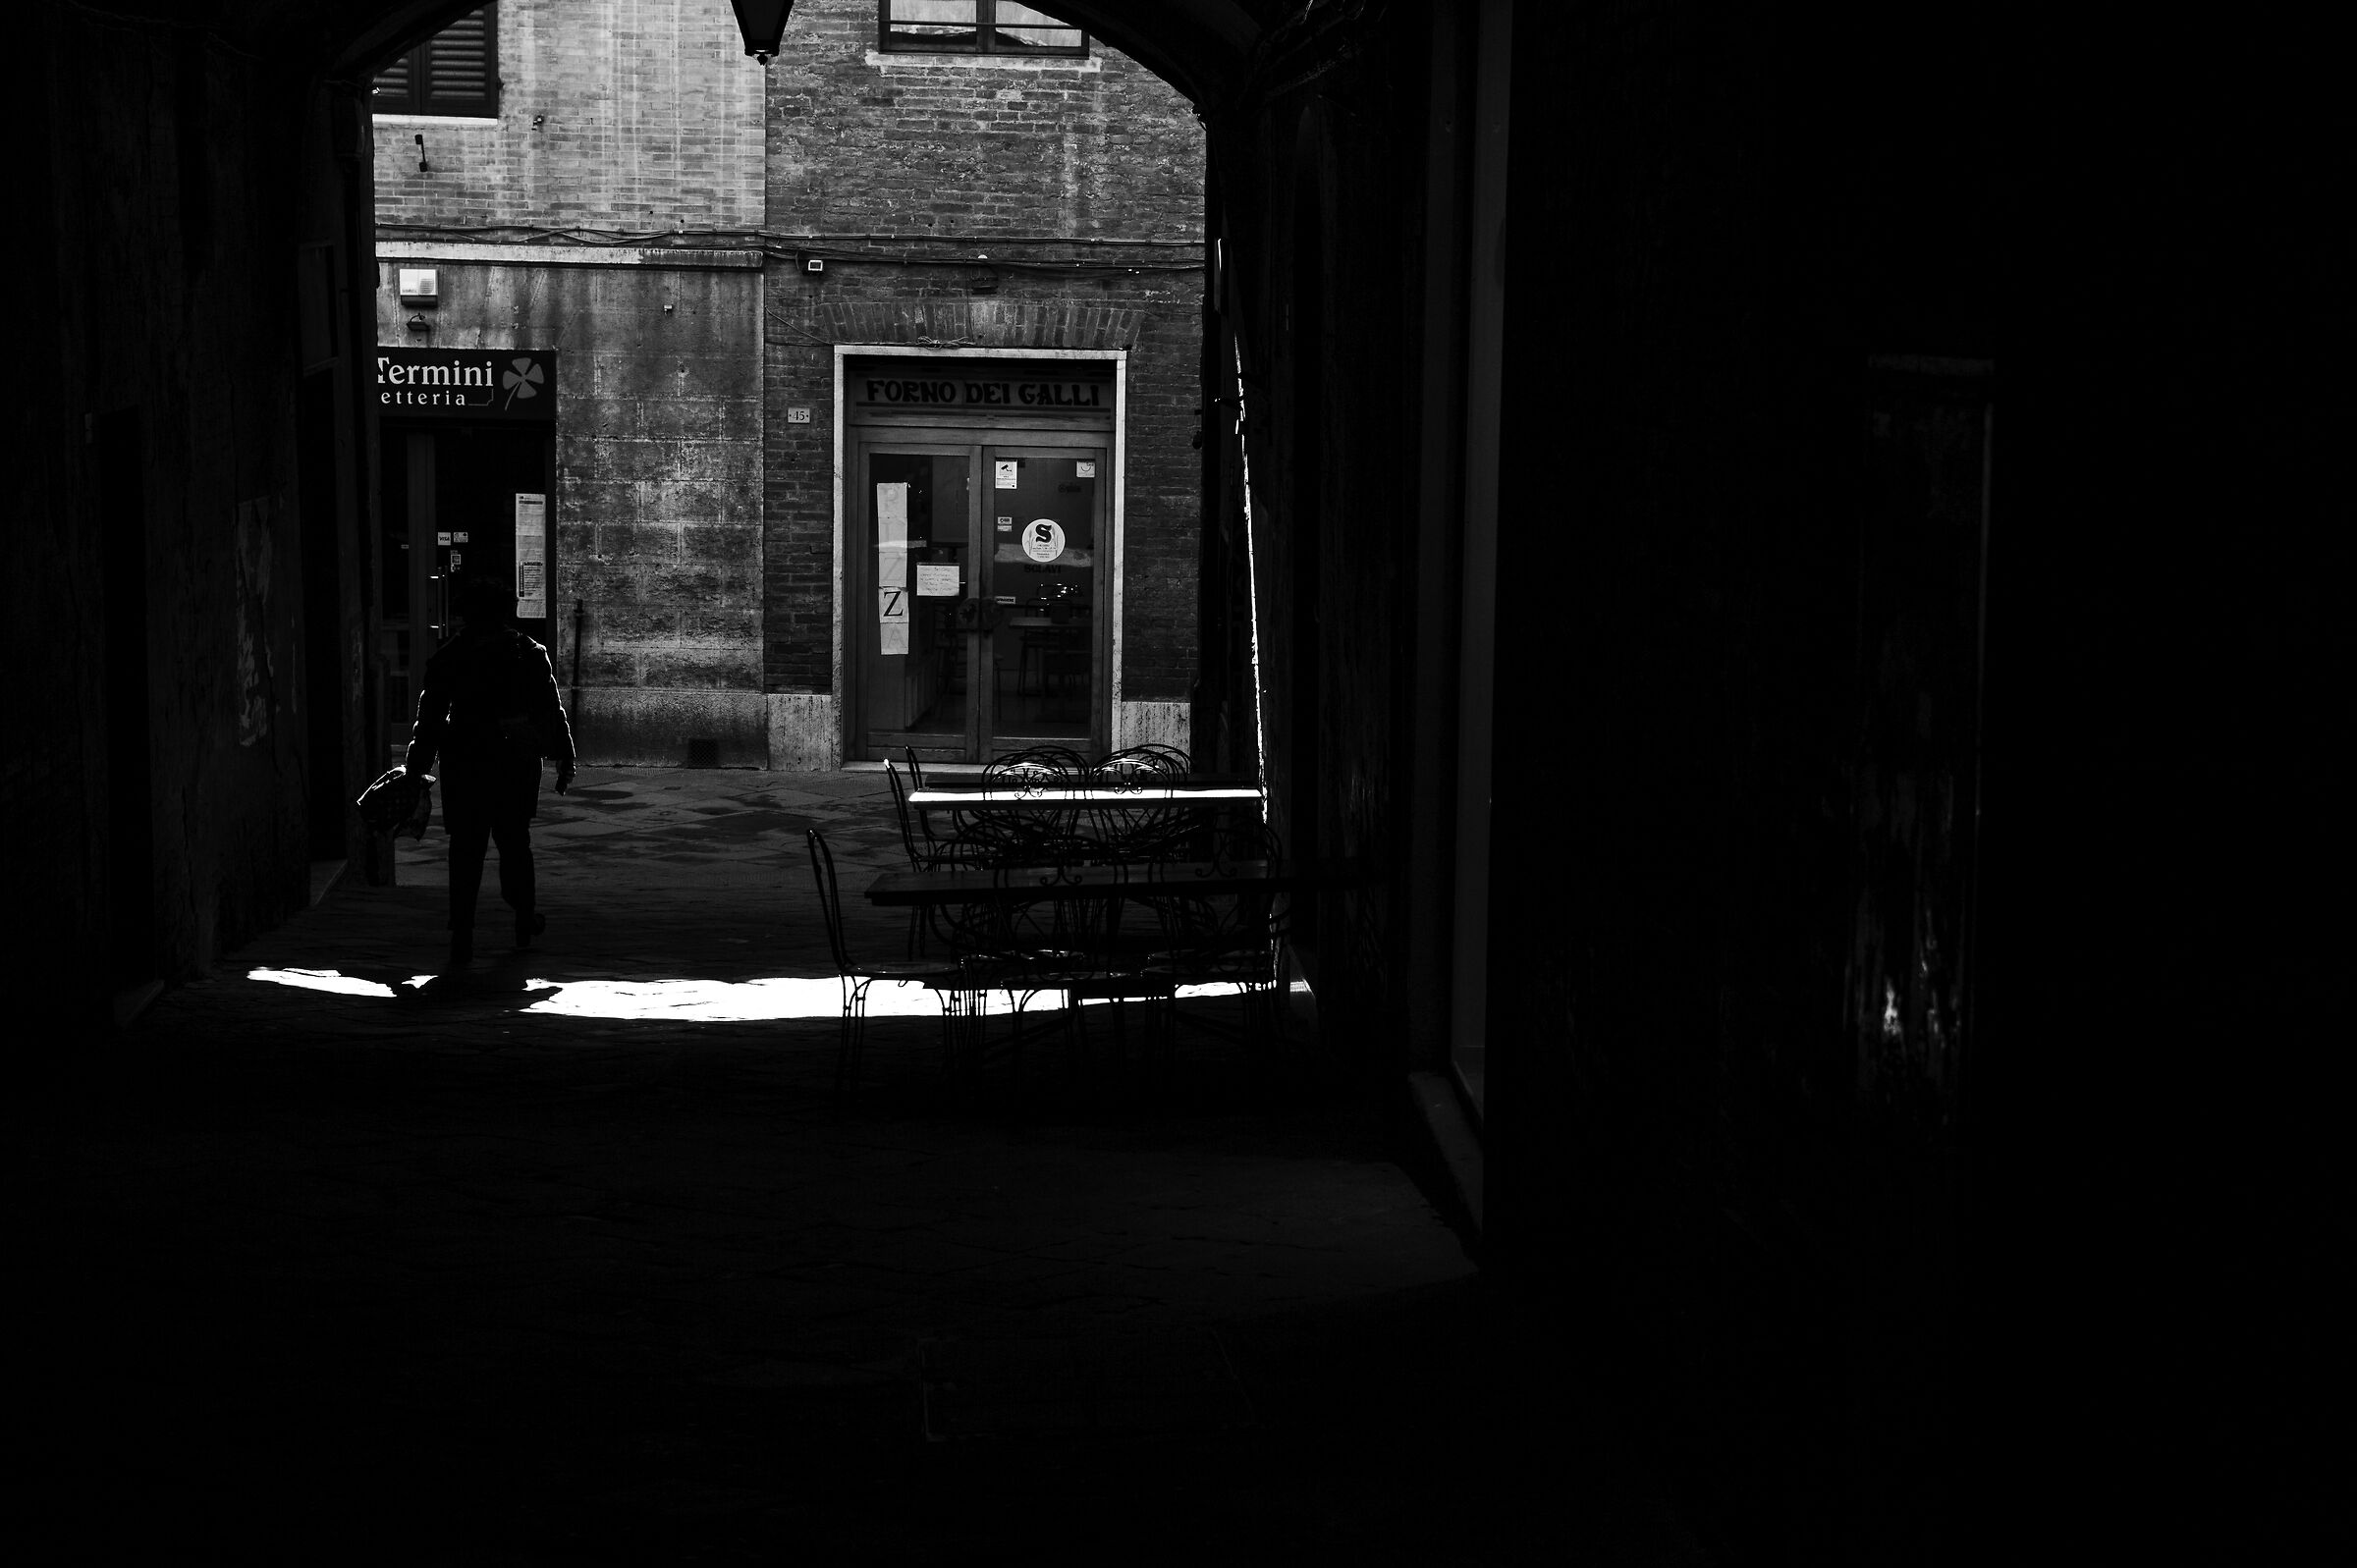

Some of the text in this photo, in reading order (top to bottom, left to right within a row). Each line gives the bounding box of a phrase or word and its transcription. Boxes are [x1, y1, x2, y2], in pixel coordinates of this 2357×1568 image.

[378, 357, 493, 386] Termini
[381, 390, 466, 406] etteria
[866, 380, 1100, 406] FORNO DEI GALLI
